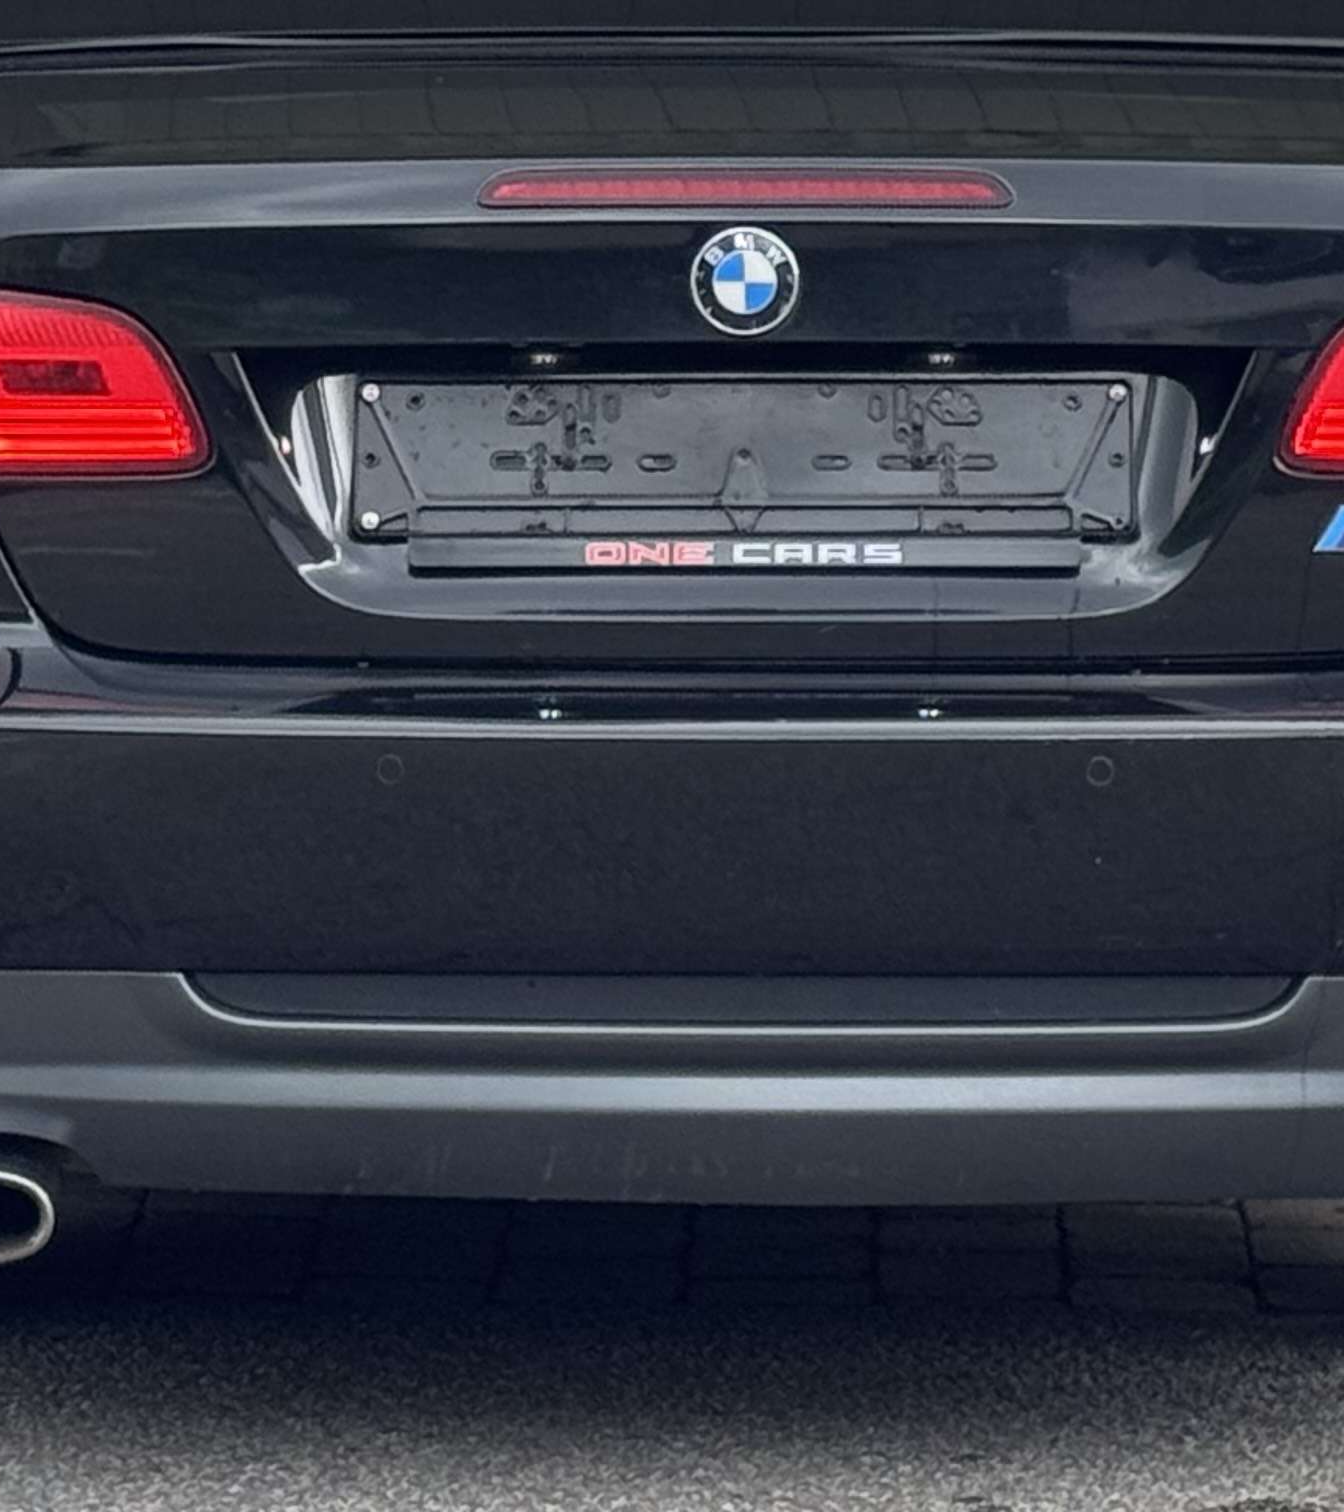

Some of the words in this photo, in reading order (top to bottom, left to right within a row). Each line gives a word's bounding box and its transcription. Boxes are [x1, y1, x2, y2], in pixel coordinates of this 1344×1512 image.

[703, 233, 788, 267] BMW
[585, 540, 714, 565] ONE
[732, 542, 902, 565] CARS
